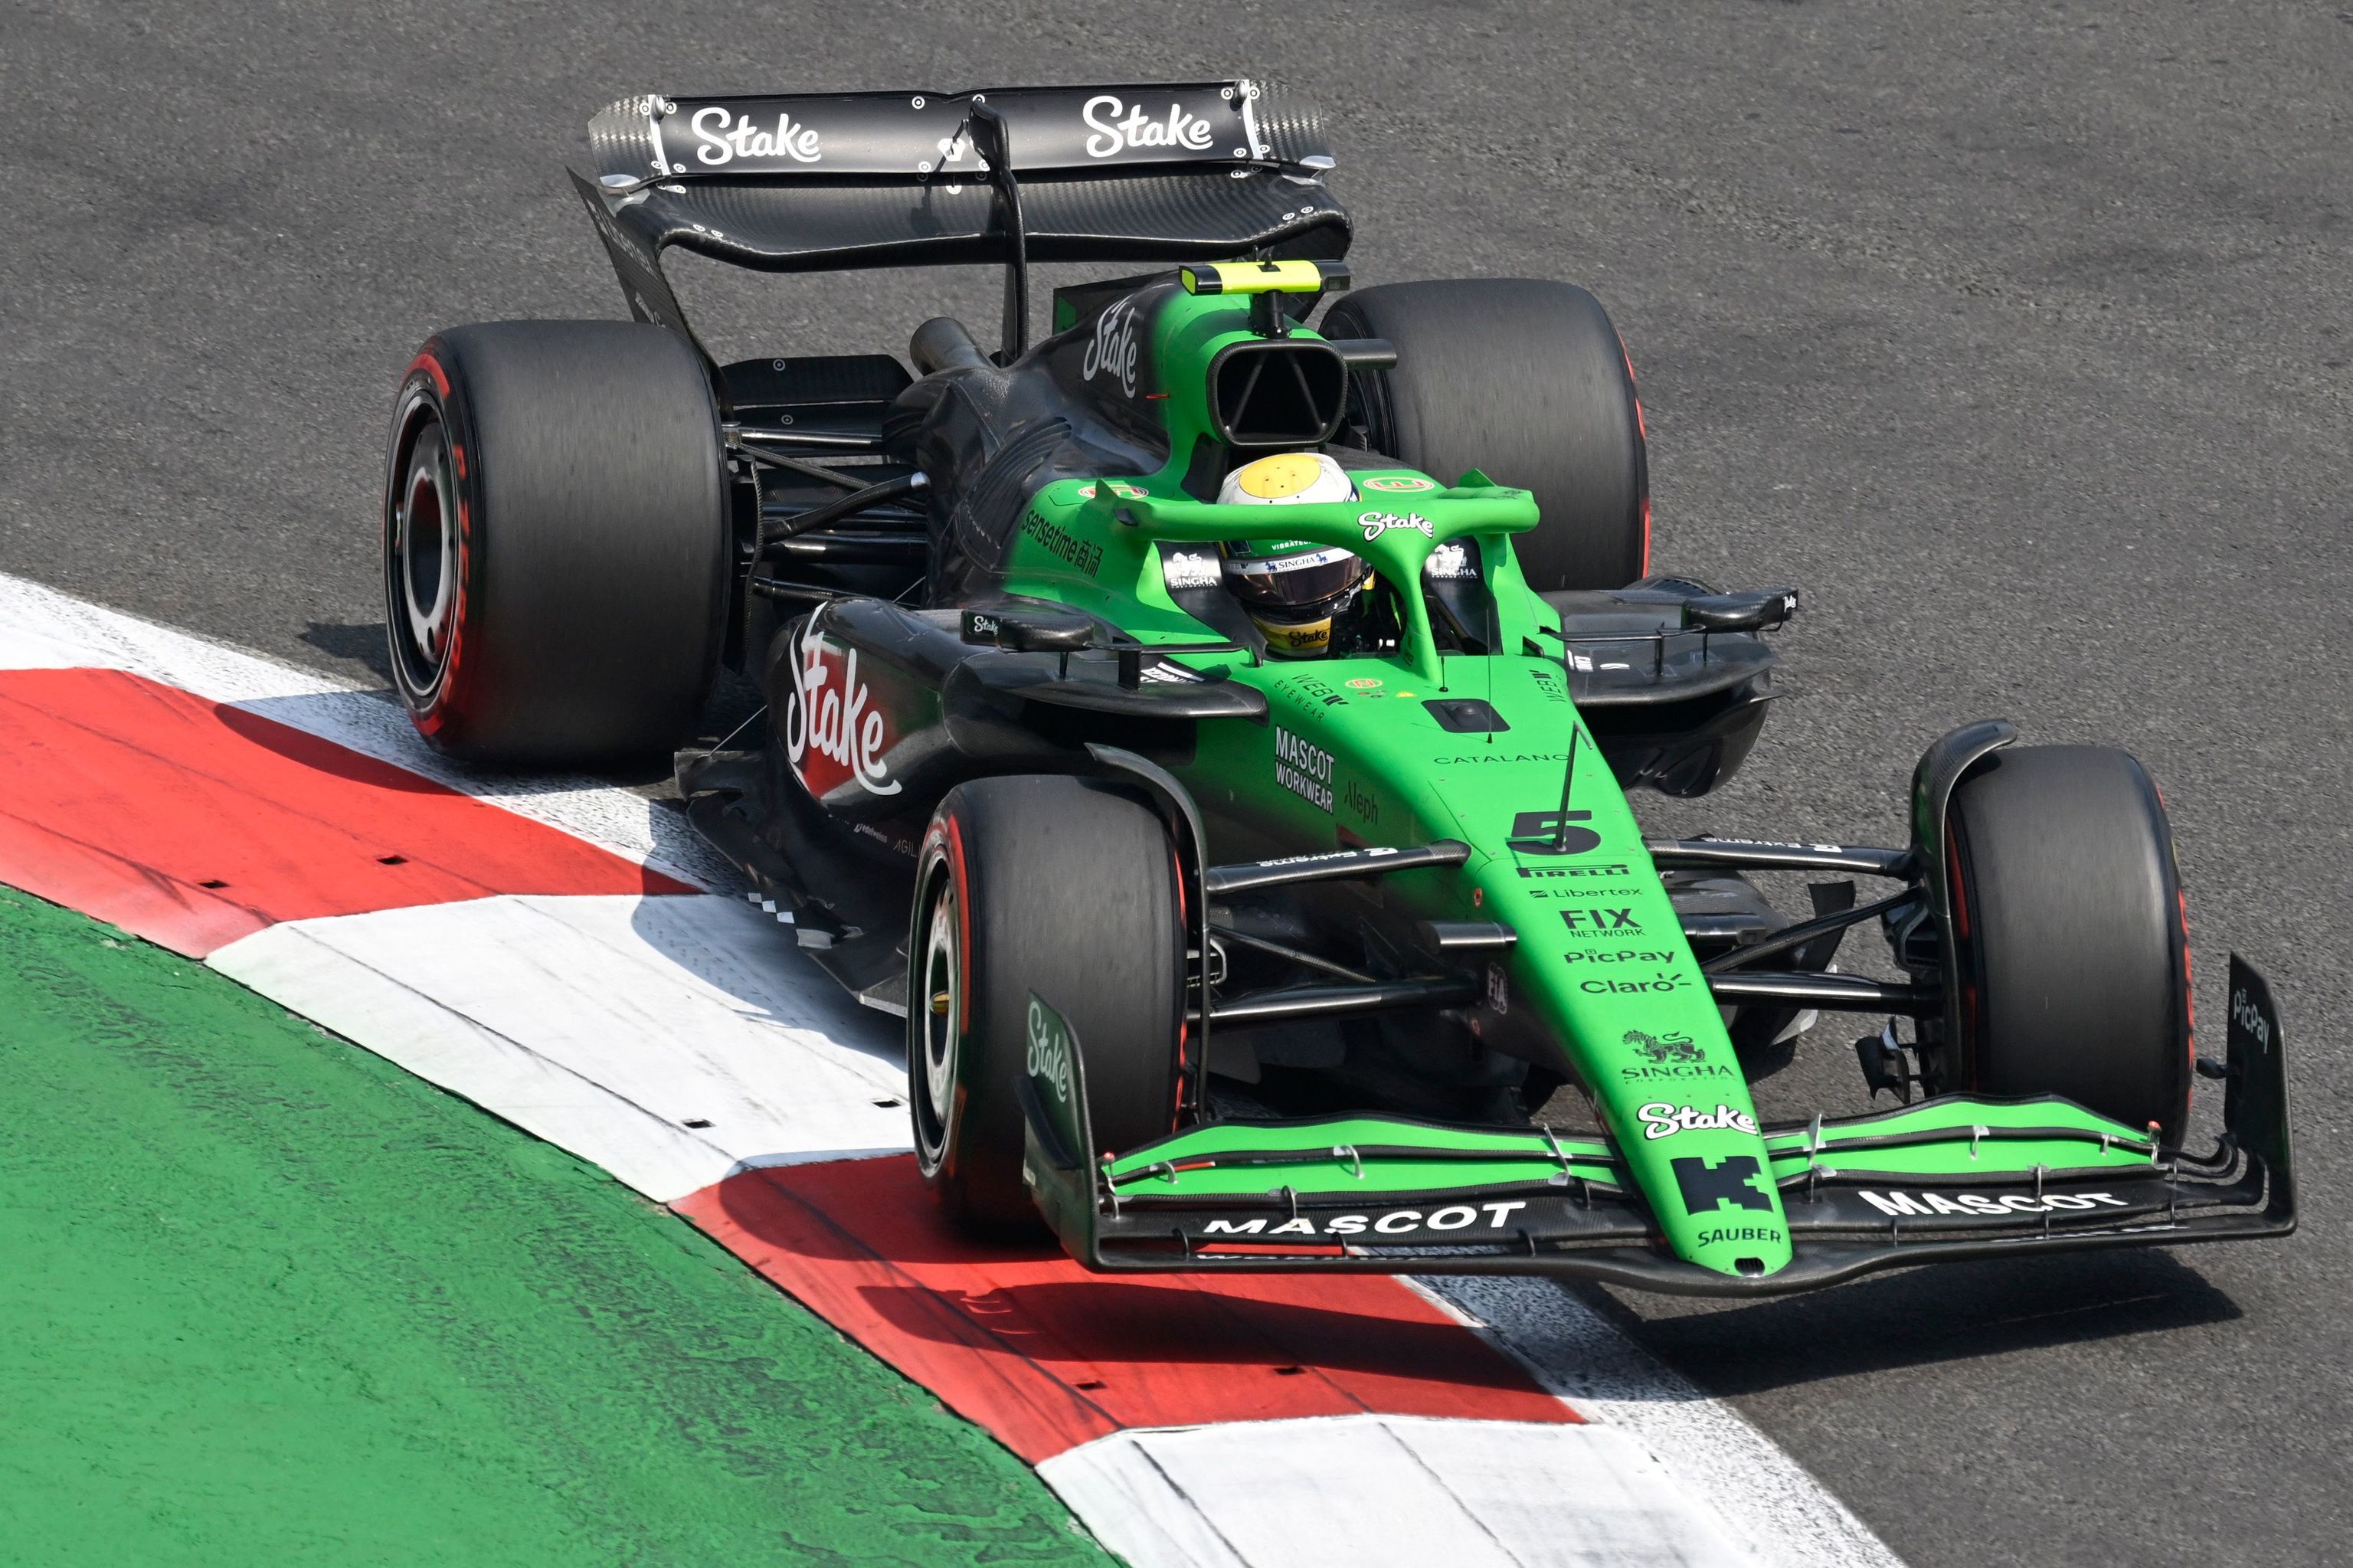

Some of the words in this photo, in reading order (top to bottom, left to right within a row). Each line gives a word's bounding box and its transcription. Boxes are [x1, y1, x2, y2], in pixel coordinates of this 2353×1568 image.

[691, 106, 822, 165] Stake
[1082, 96, 1213, 158] Stake
[1082, 293, 1137, 399] Stake
[1020, 509, 1078, 563] sensetime
[1356, 511, 1434, 542] Stake
[1278, 556, 1316, 569] SINGHA
[1431, 568, 1478, 576] SINGHA
[1170, 576, 1218, 586] SINGHA
[974, 615, 999, 637] Stake
[1288, 629, 1329, 647] Stake
[787, 601, 903, 796] Stake
[1291, 673, 1334, 698] WEB
[1274, 679, 1325, 723] EYEWEAR
[1275, 725, 1334, 785] MASCOT
[1275, 761, 1334, 813] WORKWEAR
[1344, 780, 1379, 826] Aleph
[1506, 810, 1602, 856] 5
[1517, 864, 1631, 878] PIRELLI
[1553, 888, 1643, 898] Libertex
[1559, 908, 1642, 929] FIX
[1569, 928, 1648, 938] NETWORK
[1563, 948, 1675, 964] PicPay
[1579, 977, 1679, 994] Claro
[2234, 987, 2270, 1054] PicPay
[1027, 1000, 1067, 1103] Stake
[1621, 1066, 1736, 1080] SINGHA
[1636, 1102, 1759, 1140] Stake
[1857, 1190, 2129, 1216] MASCOT
[1203, 1201, 1527, 1235] MASCOT
[1697, 1228, 1782, 1248] SAUBER
